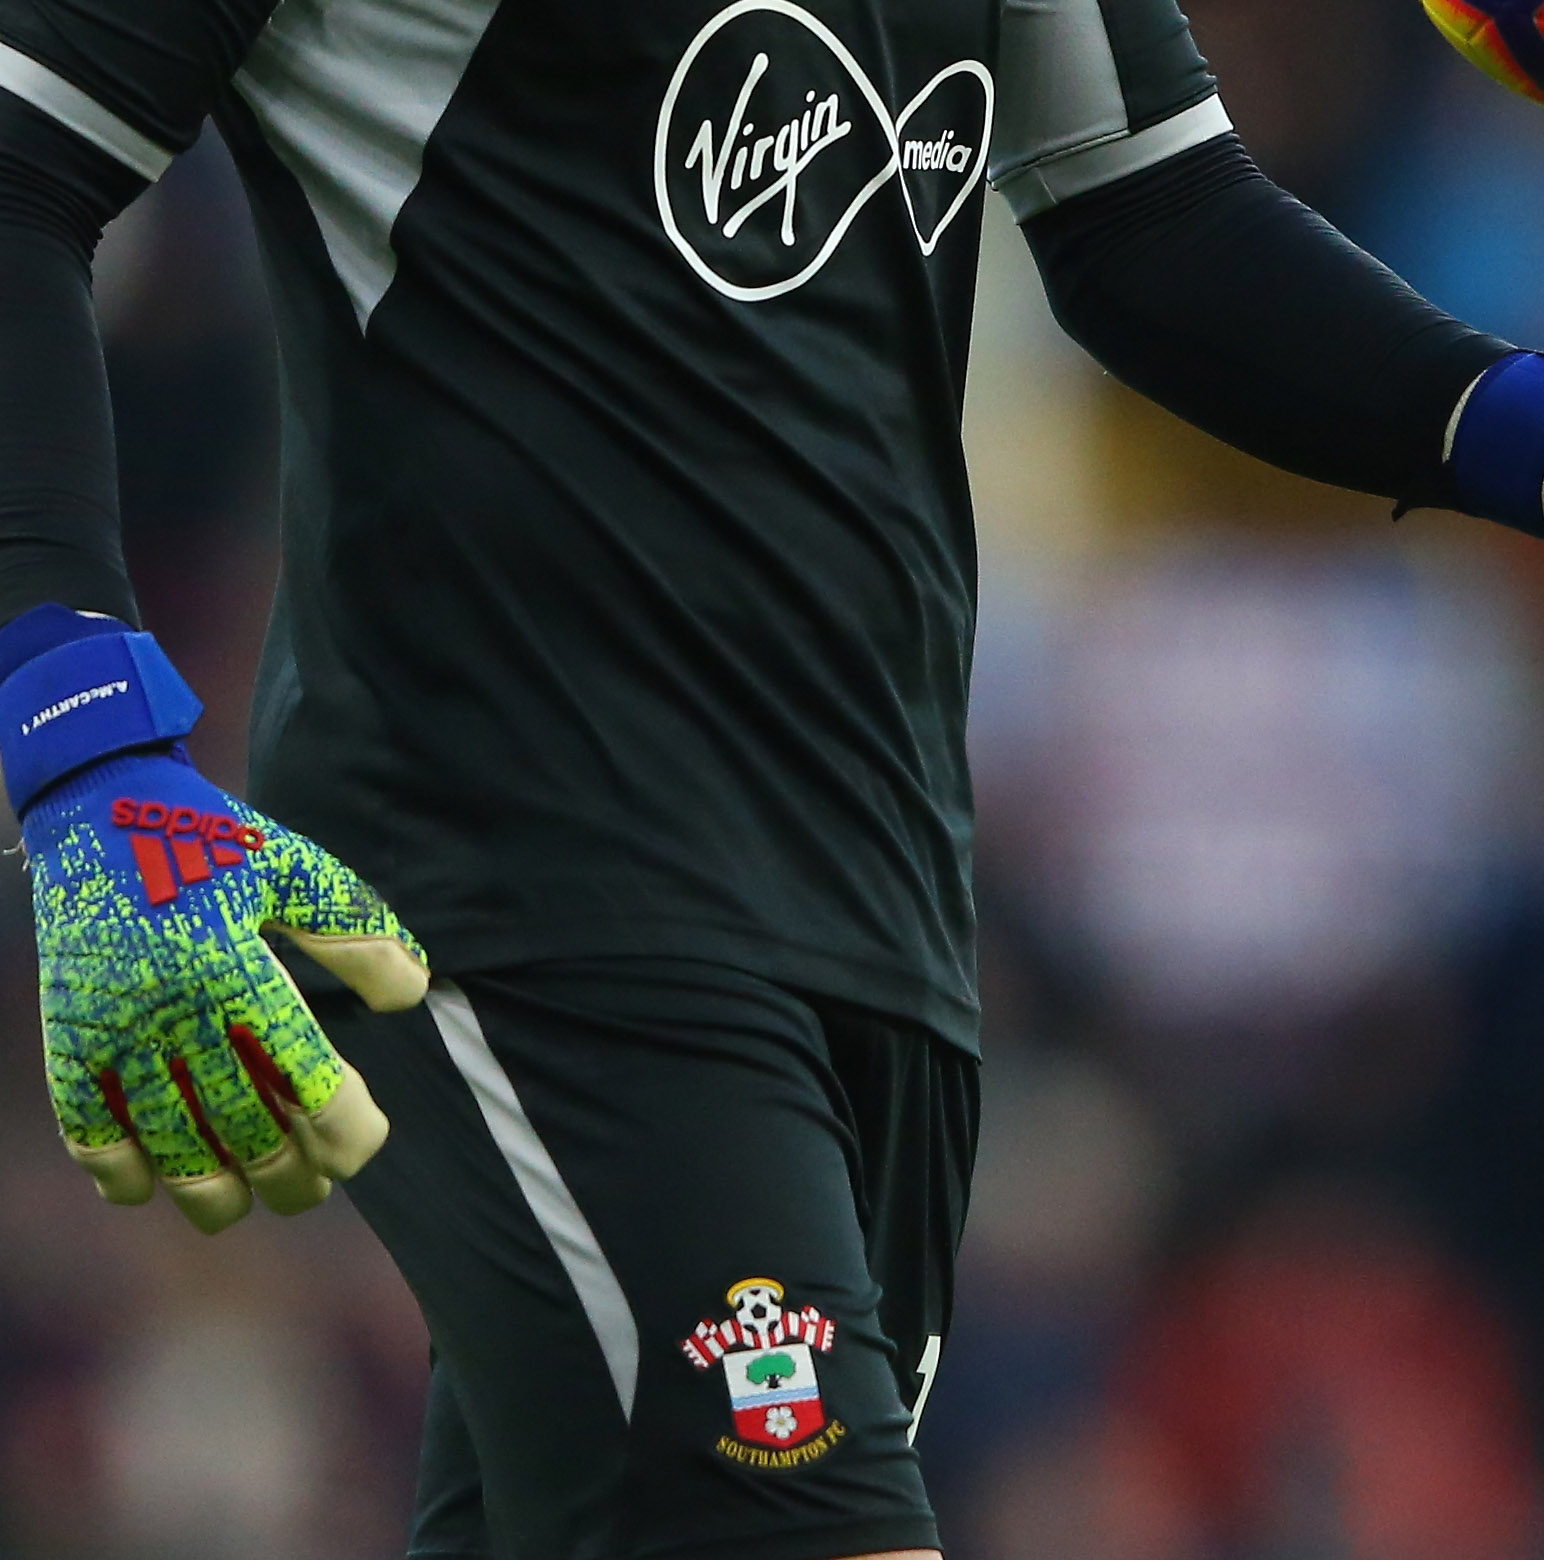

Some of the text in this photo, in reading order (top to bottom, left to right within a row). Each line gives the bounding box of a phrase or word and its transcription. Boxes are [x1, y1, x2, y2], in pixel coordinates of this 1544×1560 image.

[685, 52, 852, 246] Virgin
[902, 130, 973, 173] media
[111, 797, 265, 852] adidas
[716, 1419, 846, 1468] SOUTHAMPTON FC
